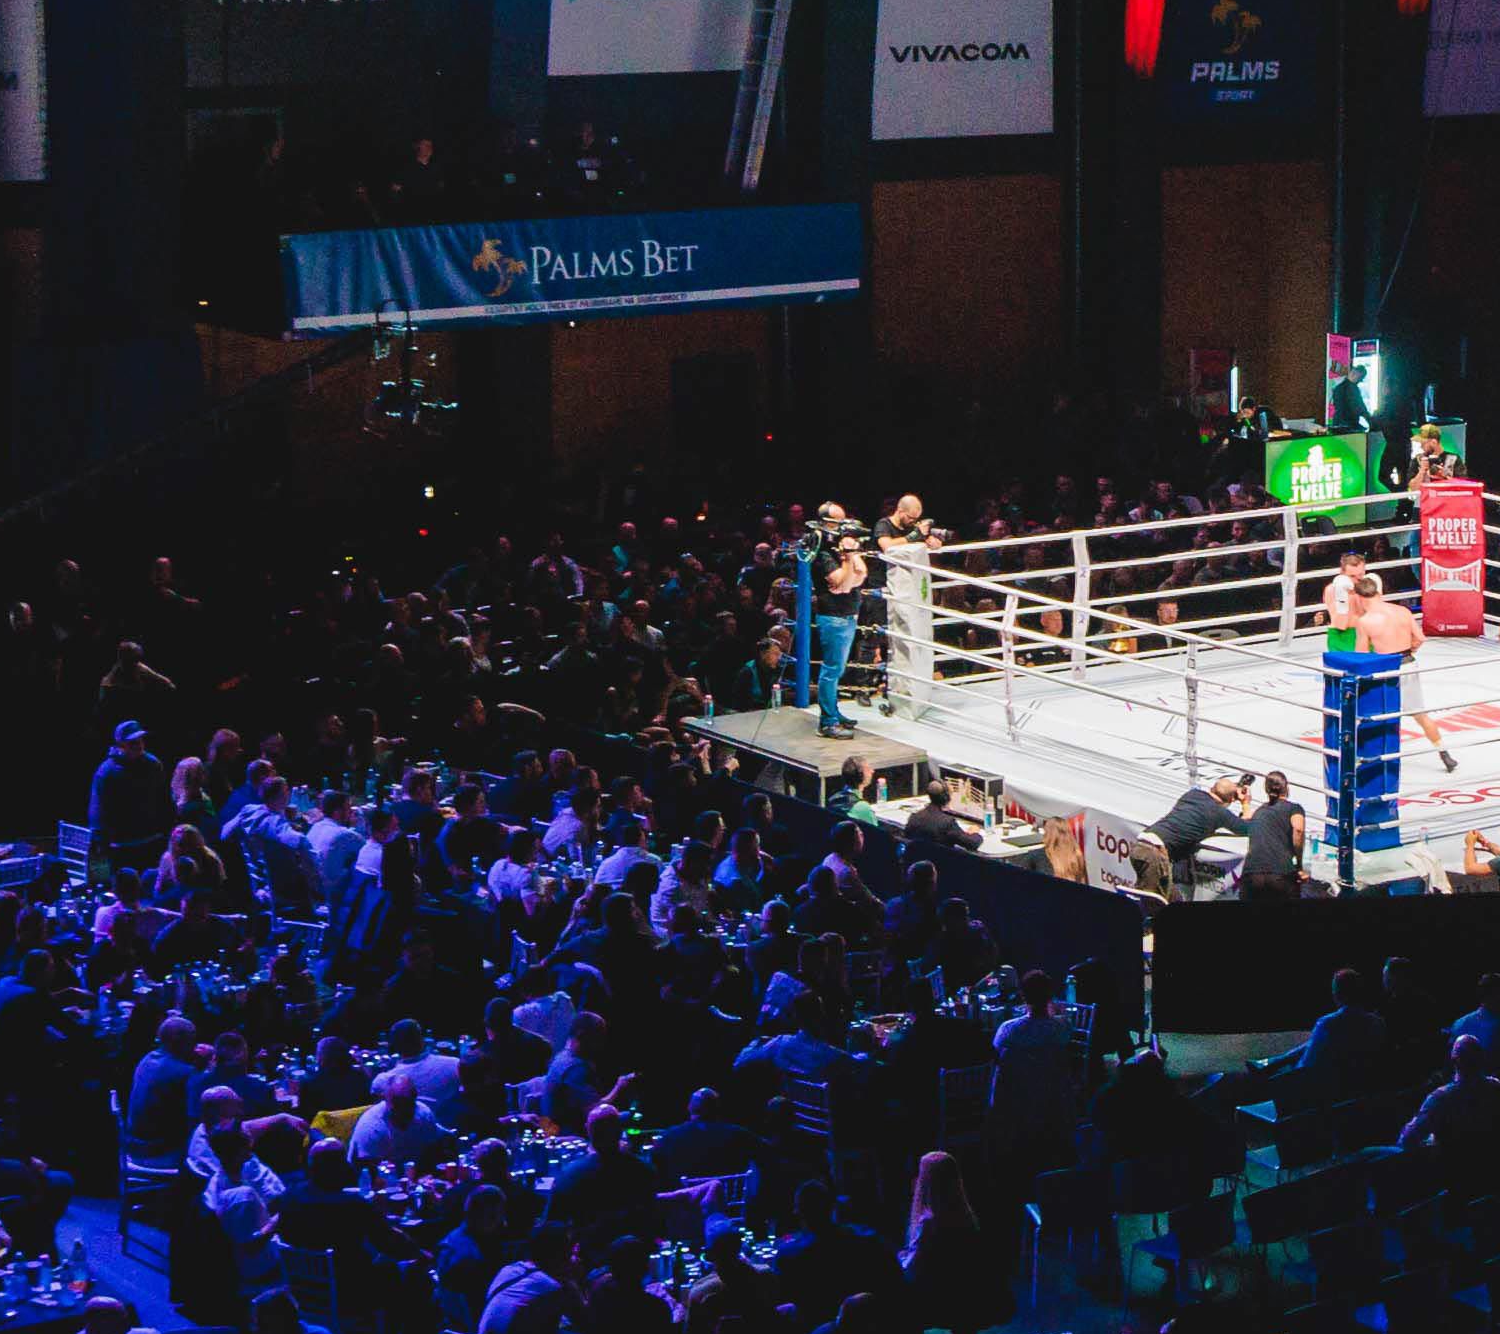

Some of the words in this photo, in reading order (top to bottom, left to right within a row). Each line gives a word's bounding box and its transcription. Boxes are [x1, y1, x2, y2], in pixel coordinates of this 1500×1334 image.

[889, 42, 1030, 63] VIVACOM
[1190, 60, 1280, 83] PALMS
[530, 246, 635, 285] PALMS
[641, 239, 699, 278] BET
[1291, 461, 1342, 485] PROPER
[1428, 517, 1477, 532] PROPER
